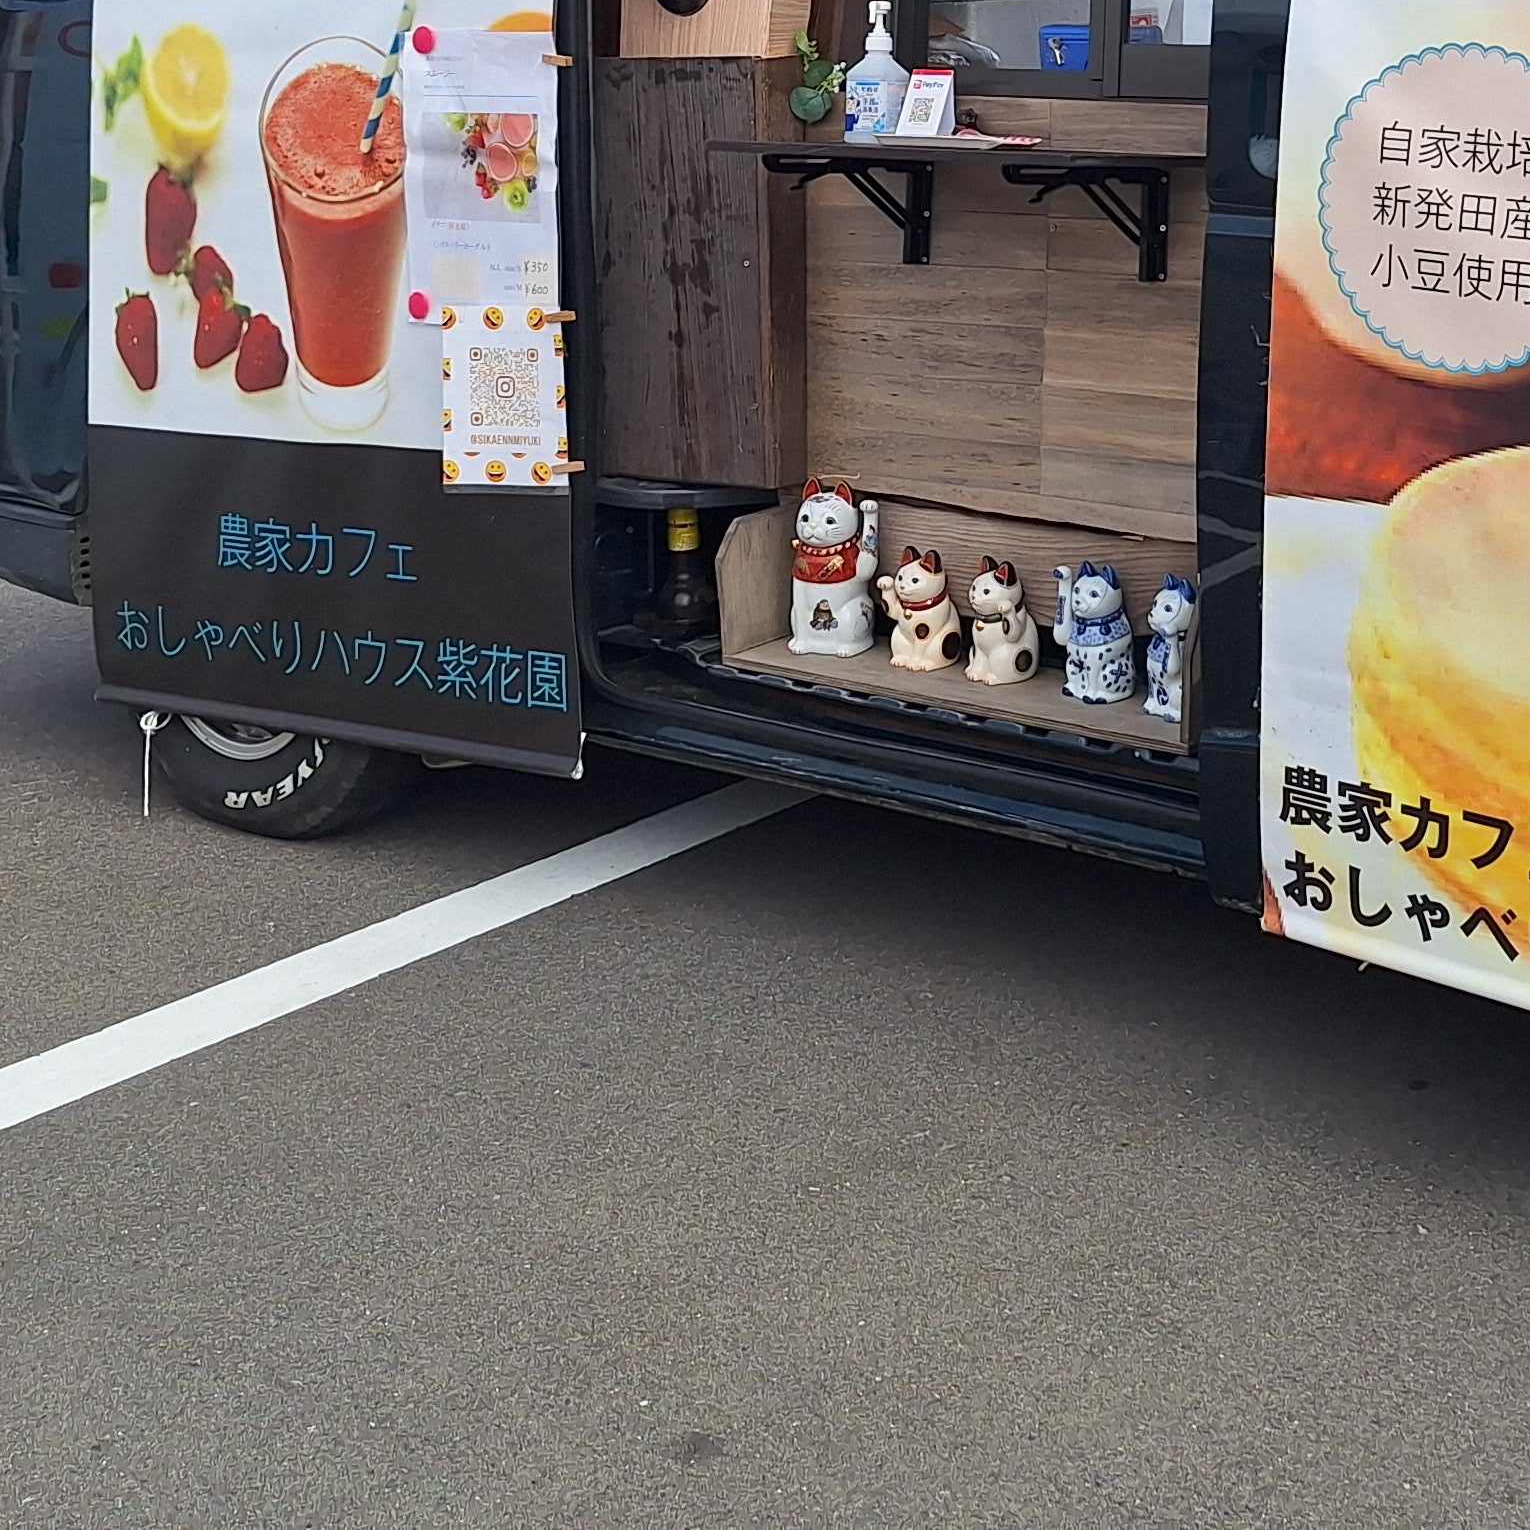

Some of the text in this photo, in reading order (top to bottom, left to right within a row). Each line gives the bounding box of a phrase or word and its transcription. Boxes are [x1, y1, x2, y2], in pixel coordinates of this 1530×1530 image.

[217, 513, 418, 581] 農家カフェ
[116, 600, 568, 712] おしゃべりハウス紫花園
